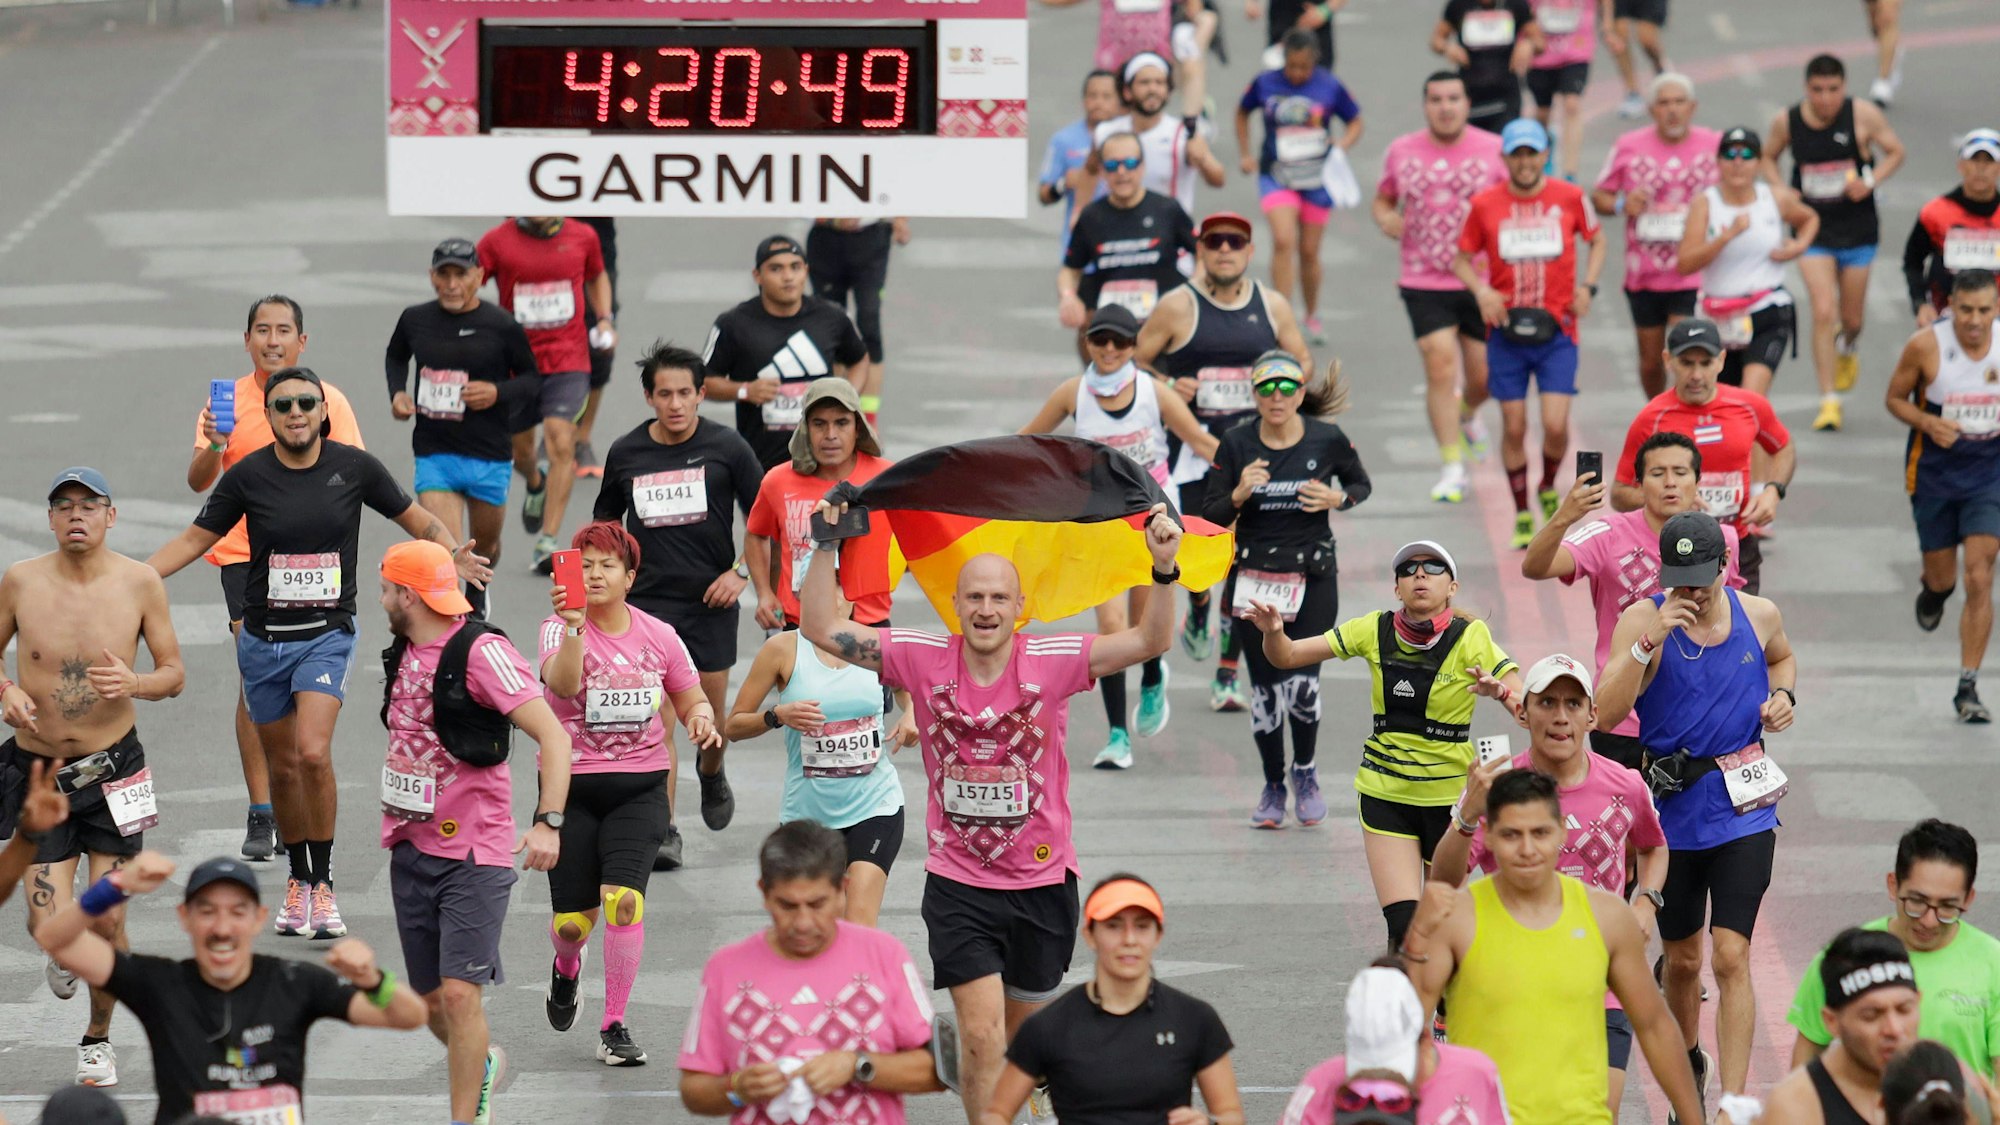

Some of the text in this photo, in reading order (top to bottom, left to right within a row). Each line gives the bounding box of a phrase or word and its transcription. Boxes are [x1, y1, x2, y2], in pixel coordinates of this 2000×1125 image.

[529, 152, 871, 203] GARMIN
[645, 486, 694, 503] 16141
[784, 500, 816, 519] WE
[282, 571, 325, 585] 9493
[1254, 580, 1292, 599] 7749
[599, 691, 653, 707] 28215
[814, 734, 869, 753] 19450
[956, 784, 1014, 801] 15715
